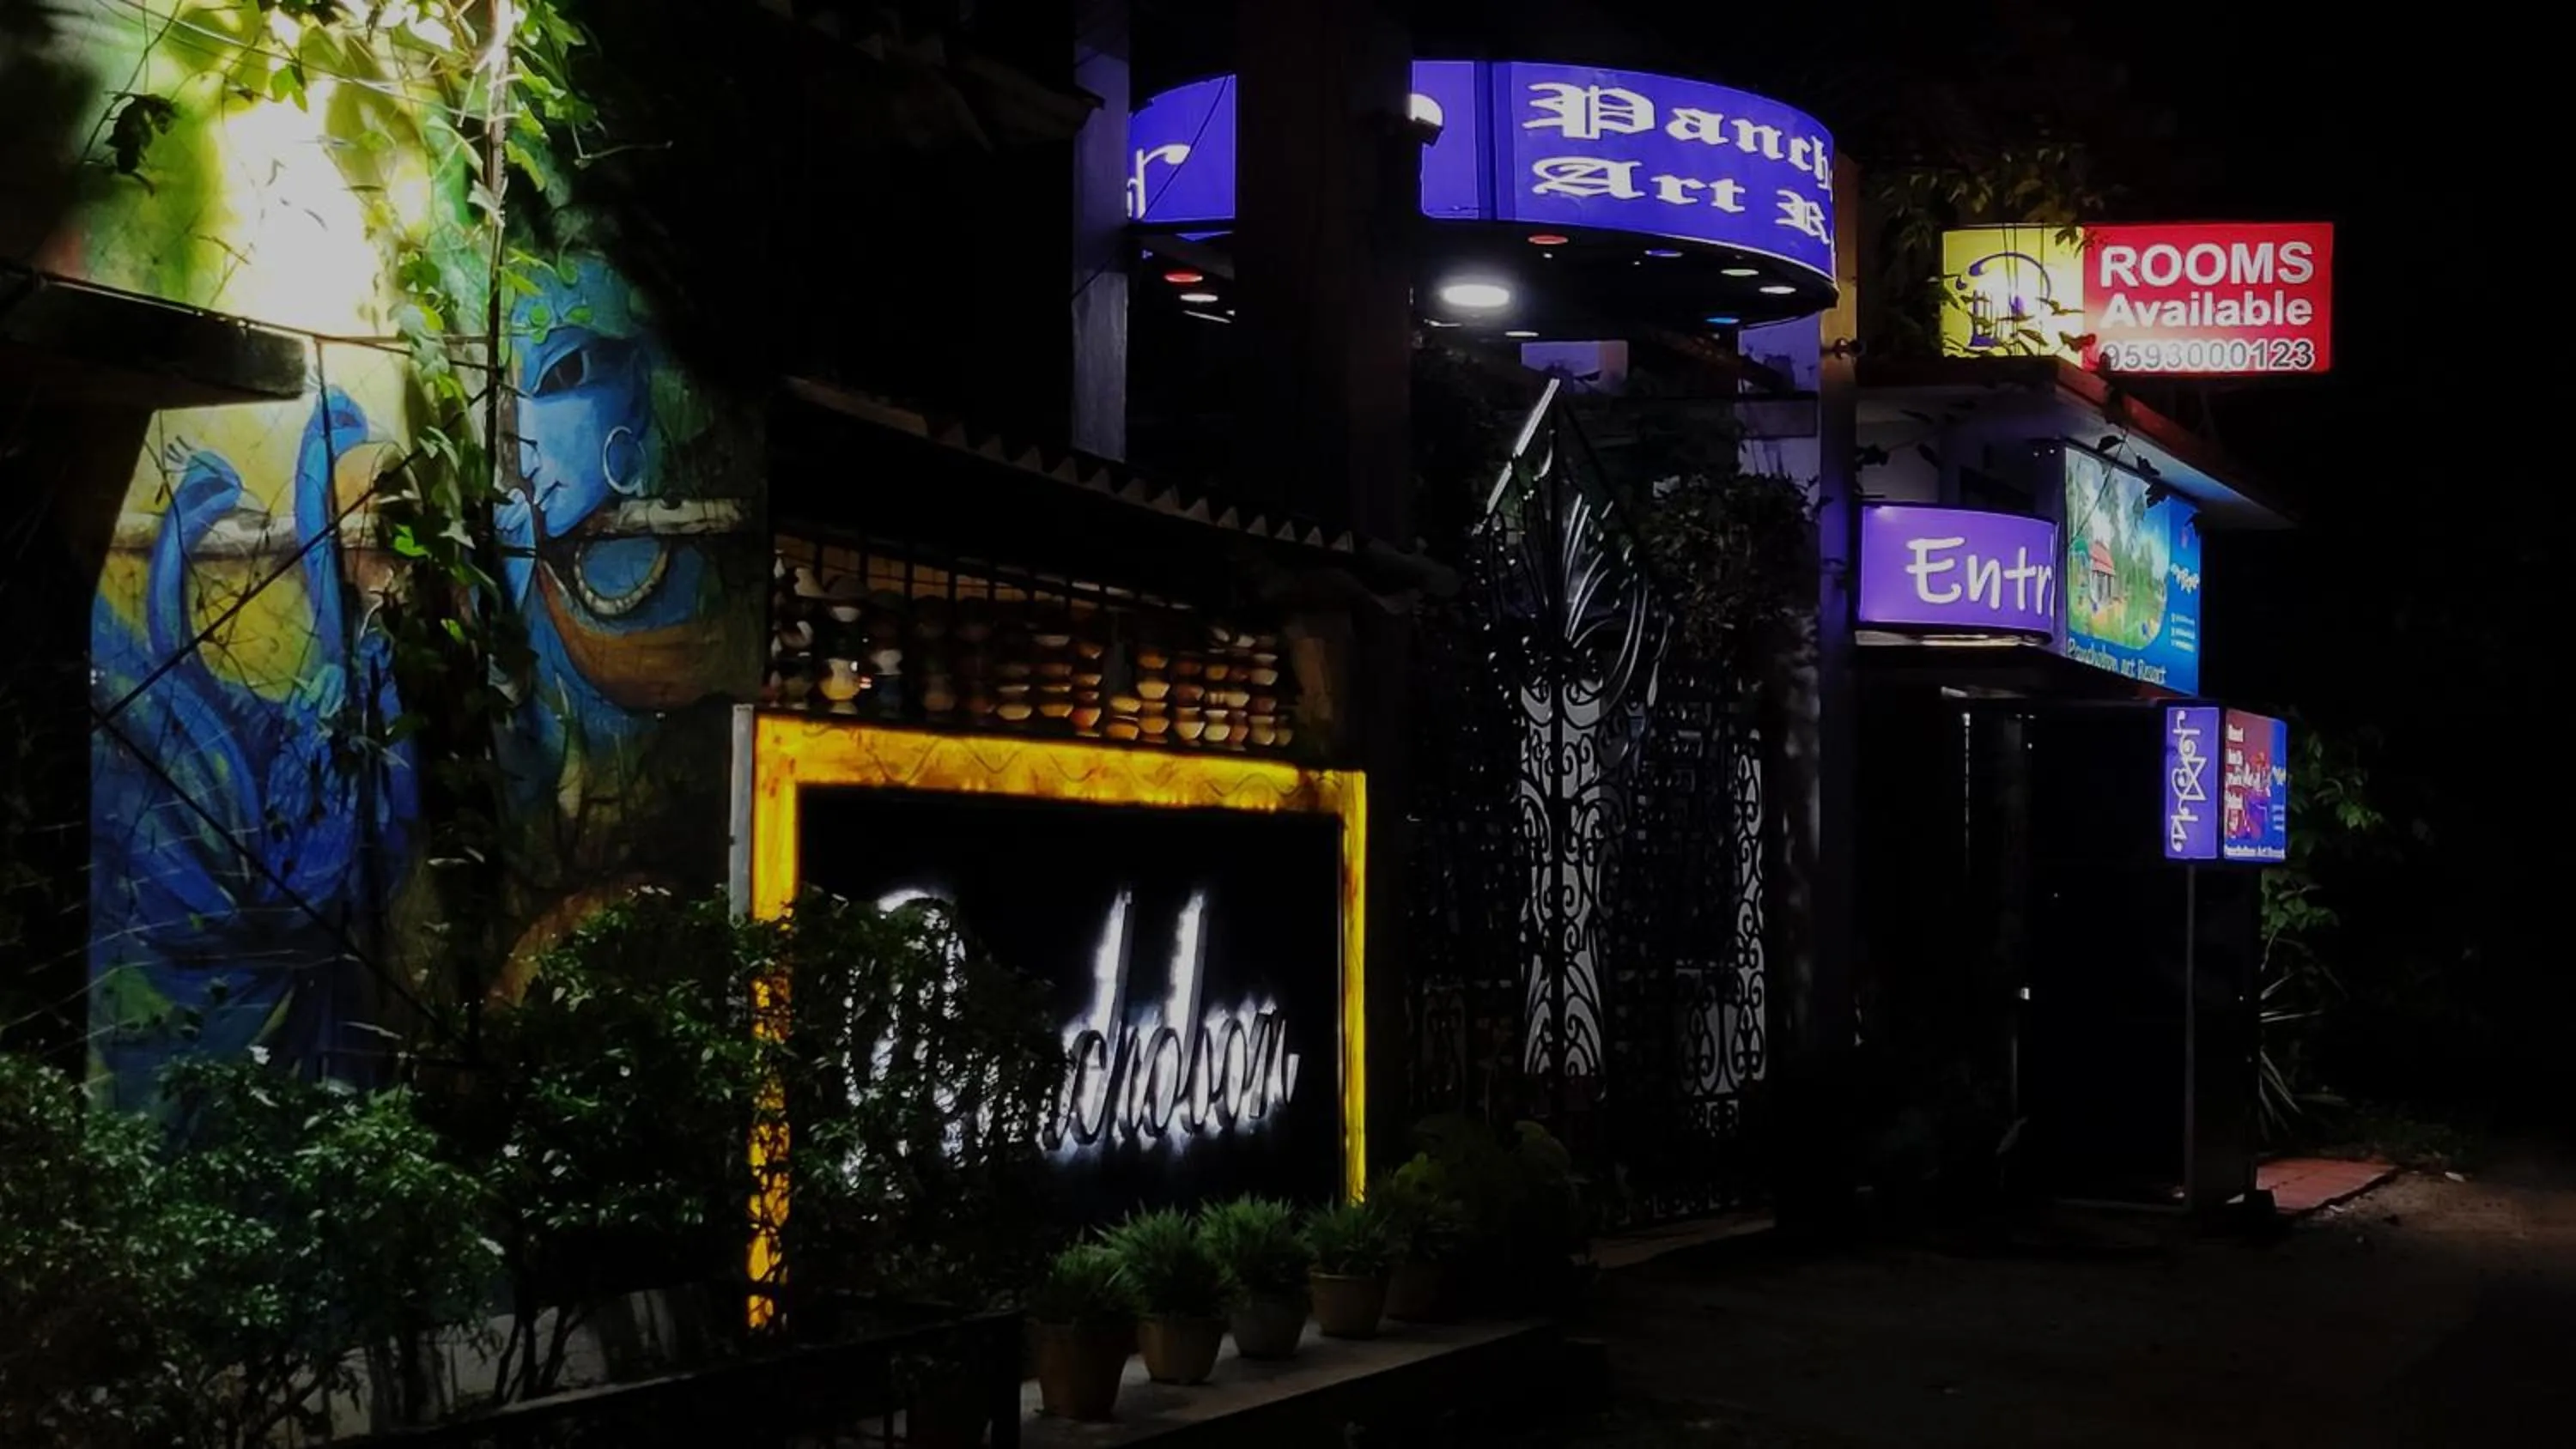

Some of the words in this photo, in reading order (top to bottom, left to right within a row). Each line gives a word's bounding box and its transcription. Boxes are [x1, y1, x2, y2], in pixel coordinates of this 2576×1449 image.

[1522, 82, 1832, 192] Panch
[1533, 157, 1746, 214] Art
[1775, 189, 1832, 245] R
[2100, 241, 2314, 288] ROOMS
[2099, 291, 2313, 328] Available
[2104, 338, 2315, 371] 9593000123
[1905, 536, 2054, 616] Entr
